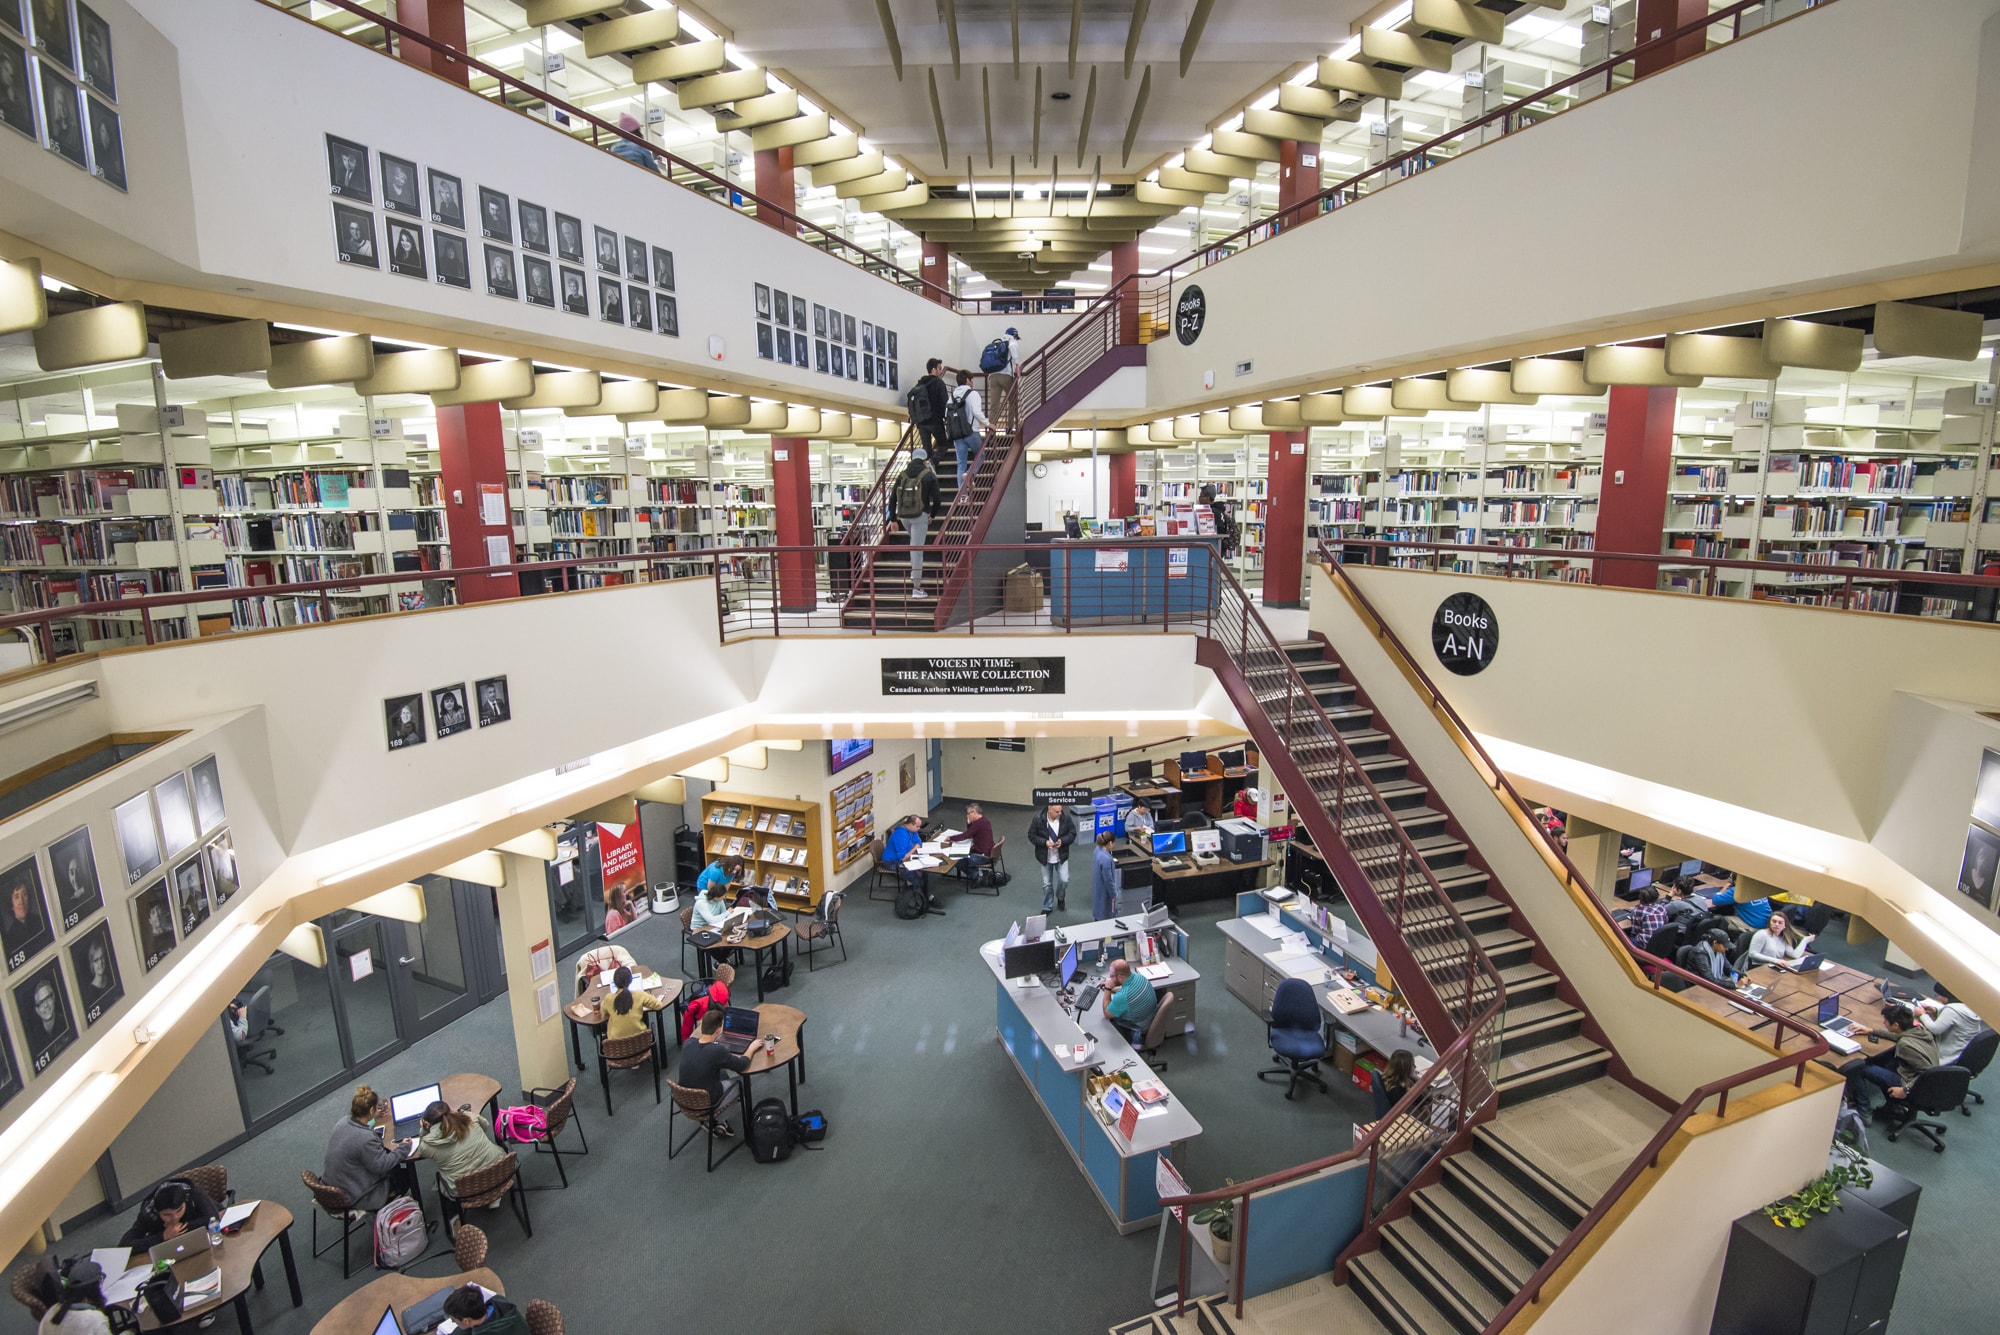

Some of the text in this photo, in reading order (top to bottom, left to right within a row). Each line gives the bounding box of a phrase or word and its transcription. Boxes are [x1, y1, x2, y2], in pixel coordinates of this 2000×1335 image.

[332, 185, 341, 194] 67
[385, 201, 395, 209] 68
[340, 253, 350, 262] 70
[392, 264, 400, 272] 71
[1181, 298, 1200, 313] Books
[1181, 313, 1198, 334] P-Z
[1444, 610, 1488, 629] Books
[1442, 633, 1483, 660] A-N
[929, 659, 1014, 668] VOICES IN TIME:
[897, 670, 1050, 680] THE FANSHAWE COLLECTION
[438, 728, 450, 736] 170
[390, 739, 402, 747] 169
[606, 842, 632, 859] LIBRARY
[603, 848, 637, 868] AND MEDIA
[606, 857, 636, 875] SERVICES
[130, 868, 141, 882] 163
[1960, 882, 1970, 894] 106
[64, 912, 79, 929] 159
[184, 921, 194, 935] 167
[9, 951, 26, 970] 158
[147, 954, 158, 968] 166
[88, 1006, 101, 1022] 162
[35, 1052, 50, 1071] 161
